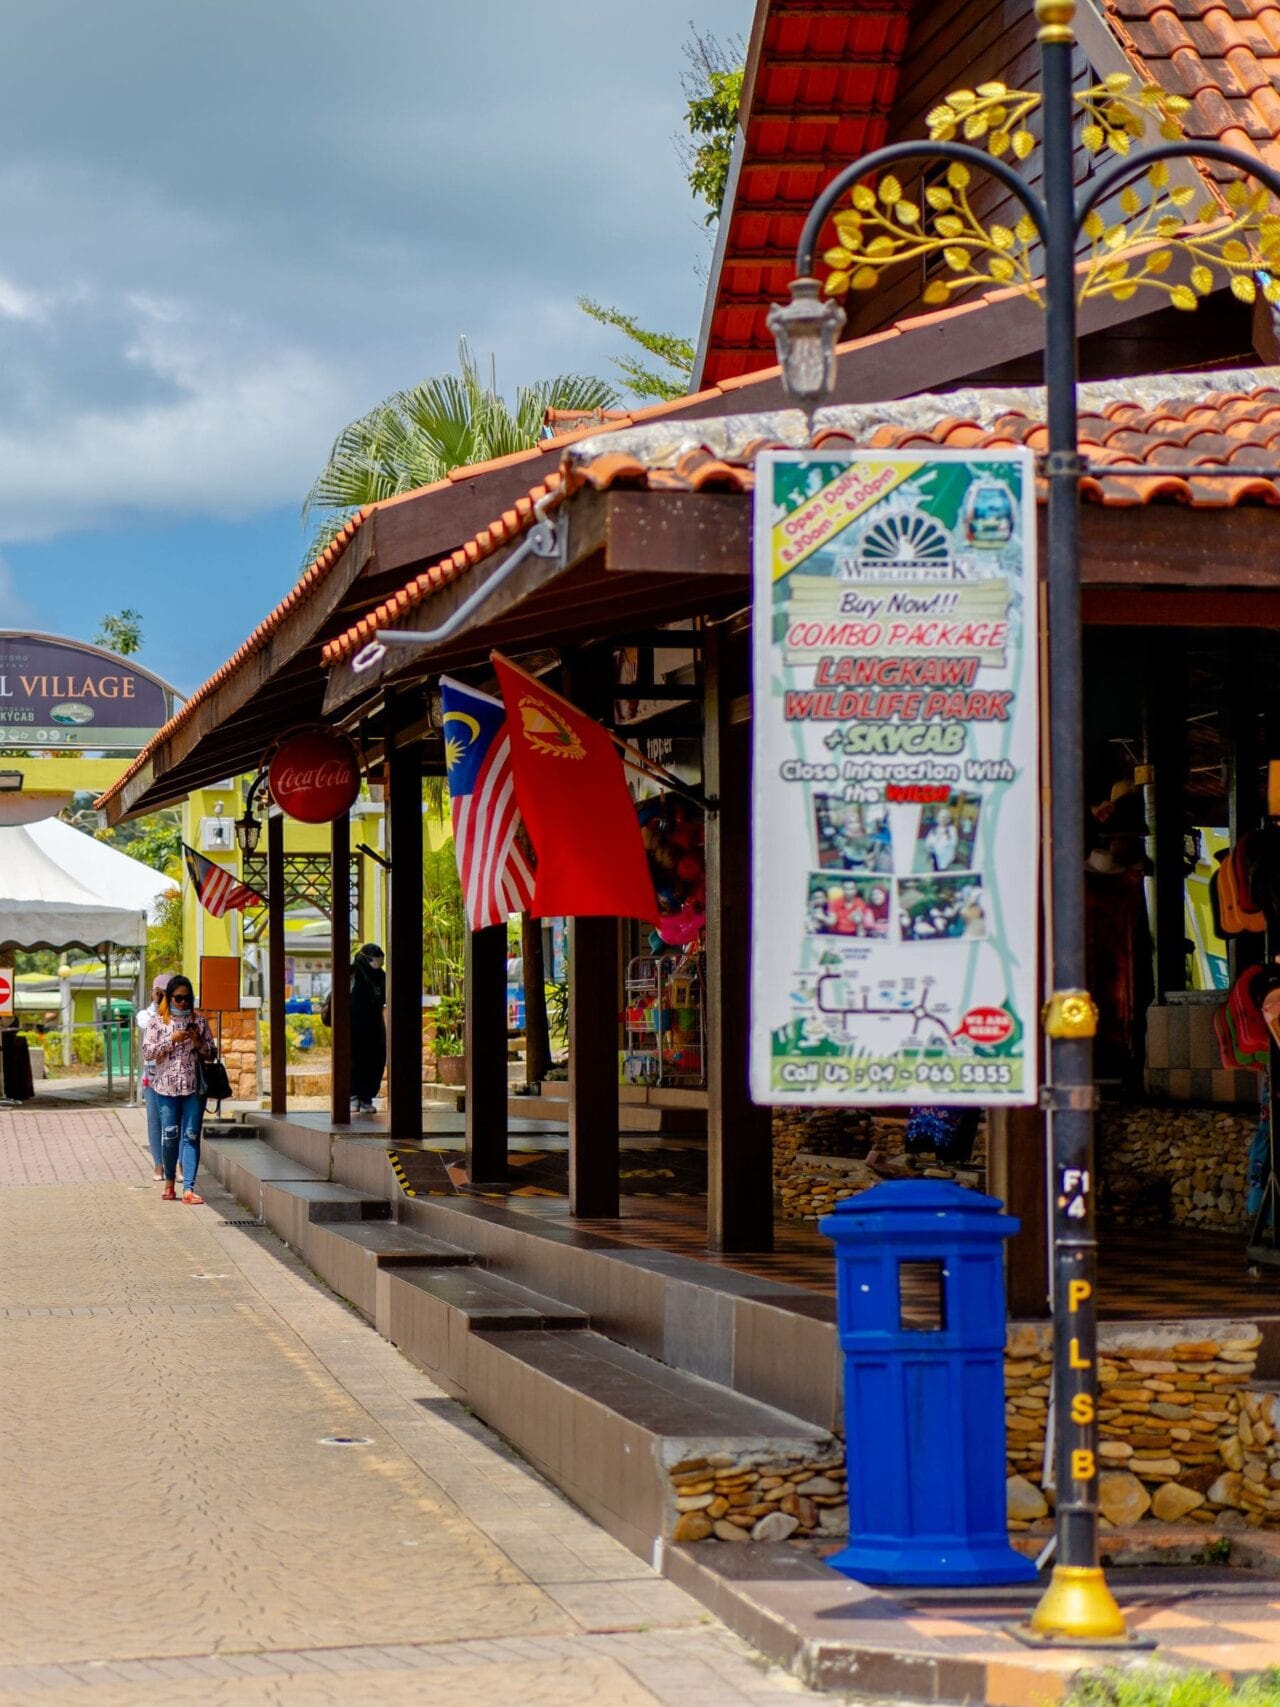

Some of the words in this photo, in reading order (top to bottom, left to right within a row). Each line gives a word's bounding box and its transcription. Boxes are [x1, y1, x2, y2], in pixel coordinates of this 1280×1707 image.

[845, 469, 895, 511] 6.00pm
[785, 504, 823, 535] Open
[823, 474, 862, 503] Daily
[841, 593, 879, 619] Buy
[887, 592, 958, 615] Now!!!
[788, 623, 881, 647] COMBO
[887, 622, 1008, 647] PACKAGE
[816, 658, 979, 687] LANGKAWI
[19, 675, 136, 698] VILLAGE
[784, 692, 920, 721] WILDLIFE
[924, 692, 1011, 721] PARK
[278, 760, 350, 795] Coca-Cola
[781, 760, 838, 781] Close
[844, 760, 959, 781] Interaction
[965, 760, 1014, 781] With
[844, 783, 881, 803] the
[781, 1064, 818, 1082] Call
[823, 1064, 850, 1082] Us
[867, 1064, 894, 1082] 04
[918, 1064, 955, 1082] 966
[961, 1064, 1011, 1082] 5855
[1064, 1170, 1090, 1194] F1
[1067, 1195, 1087, 1218] 4
